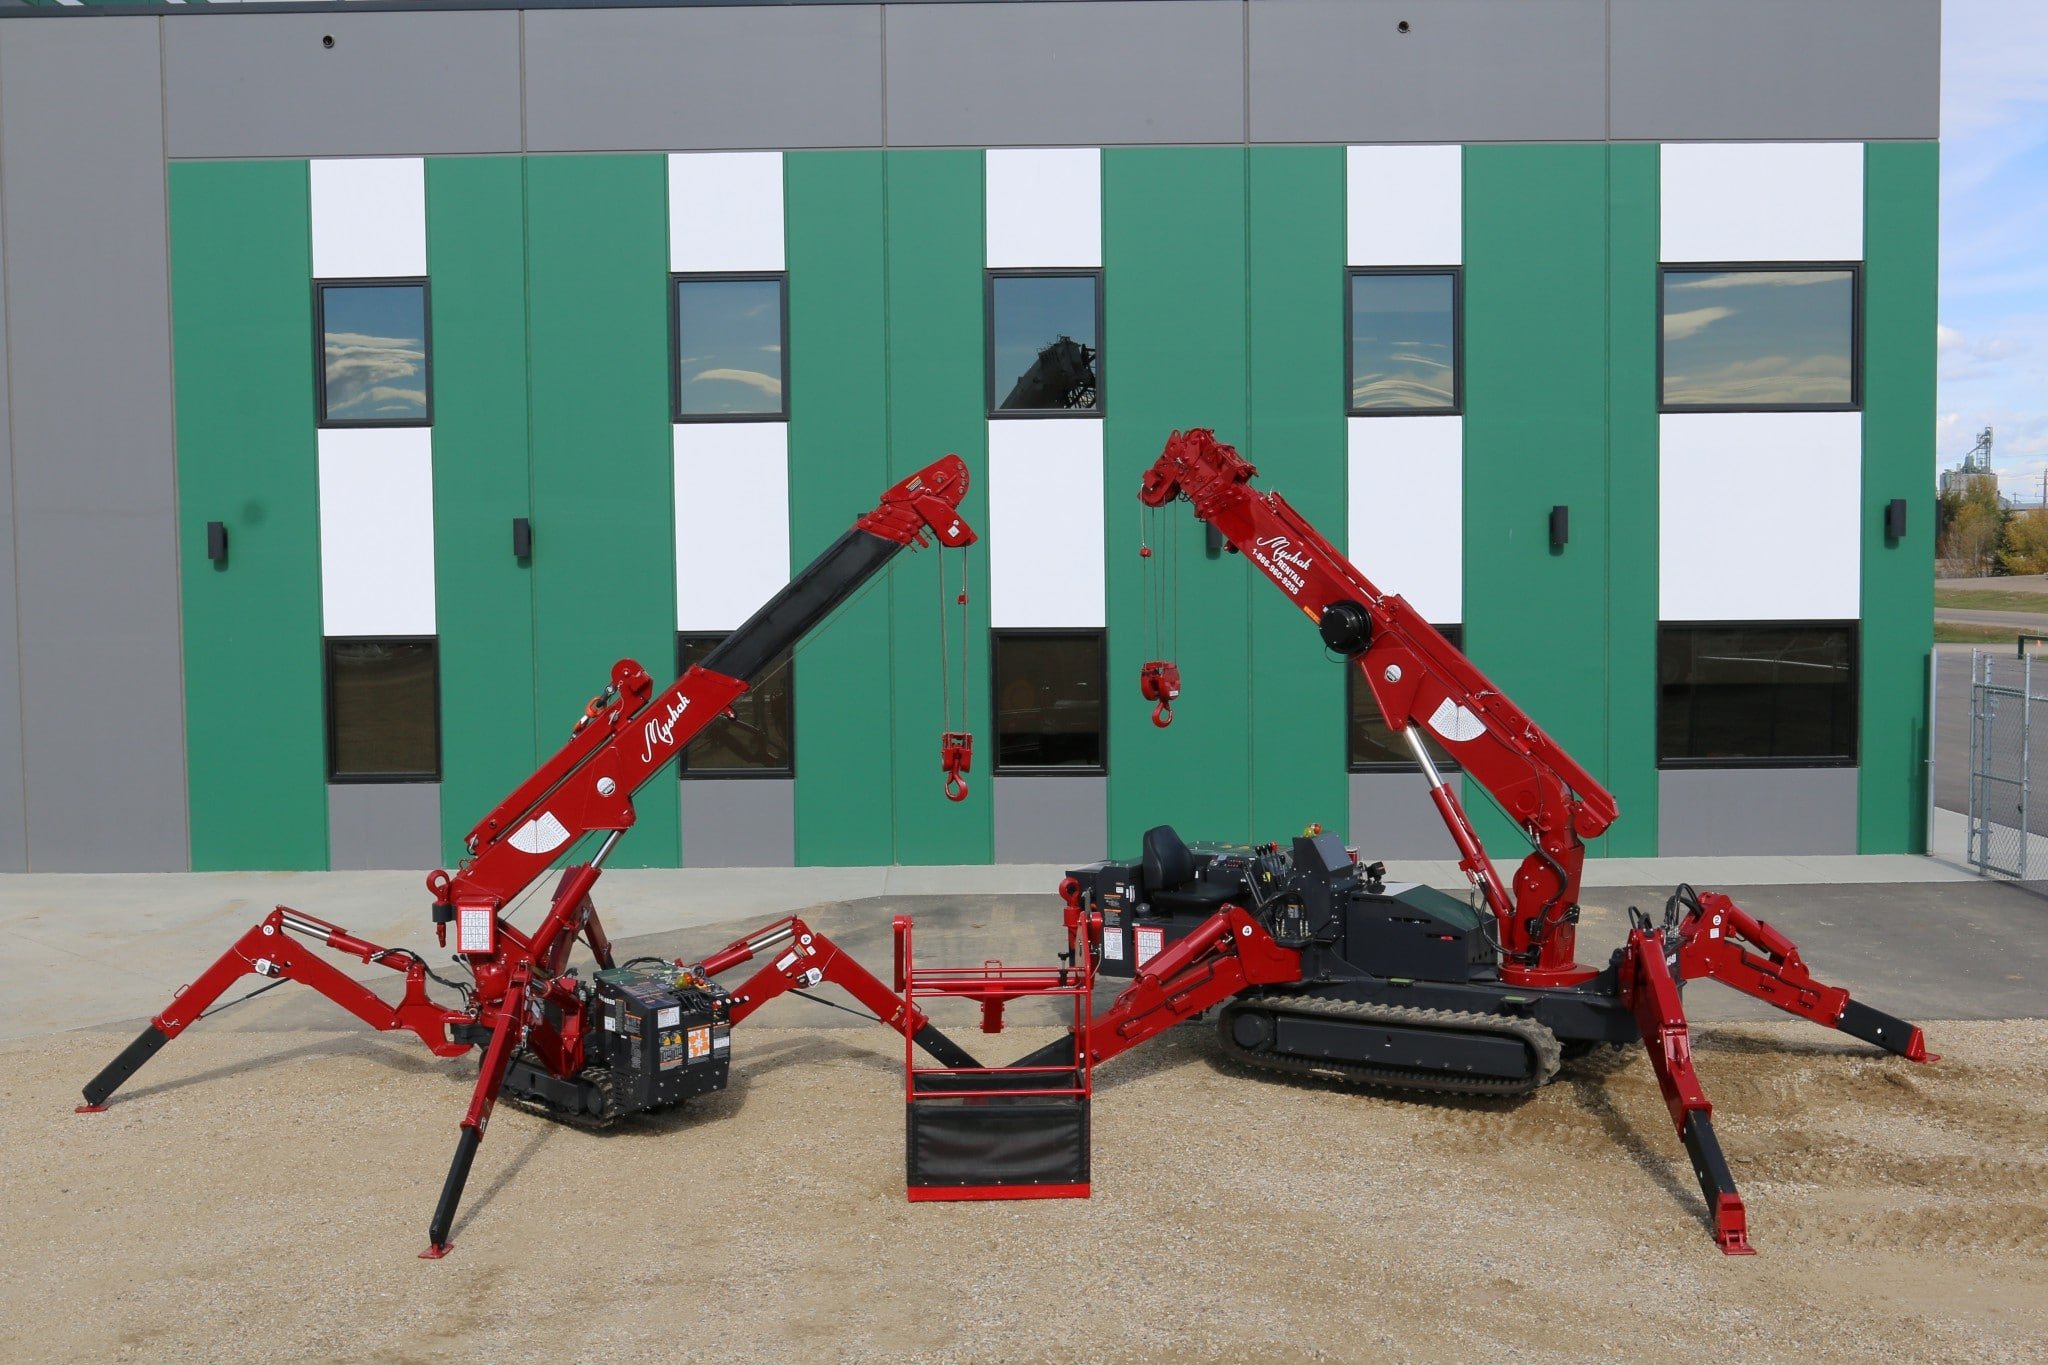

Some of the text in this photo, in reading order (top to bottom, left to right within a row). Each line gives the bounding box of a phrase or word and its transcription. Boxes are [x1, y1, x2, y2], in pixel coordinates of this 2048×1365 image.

[1252, 548, 1299, 595] 1-866-960-9255
[1256, 536, 1313, 570] Myshak
[1277, 559, 1305, 588] RENTALS
[641, 691, 690, 763] Myshak
